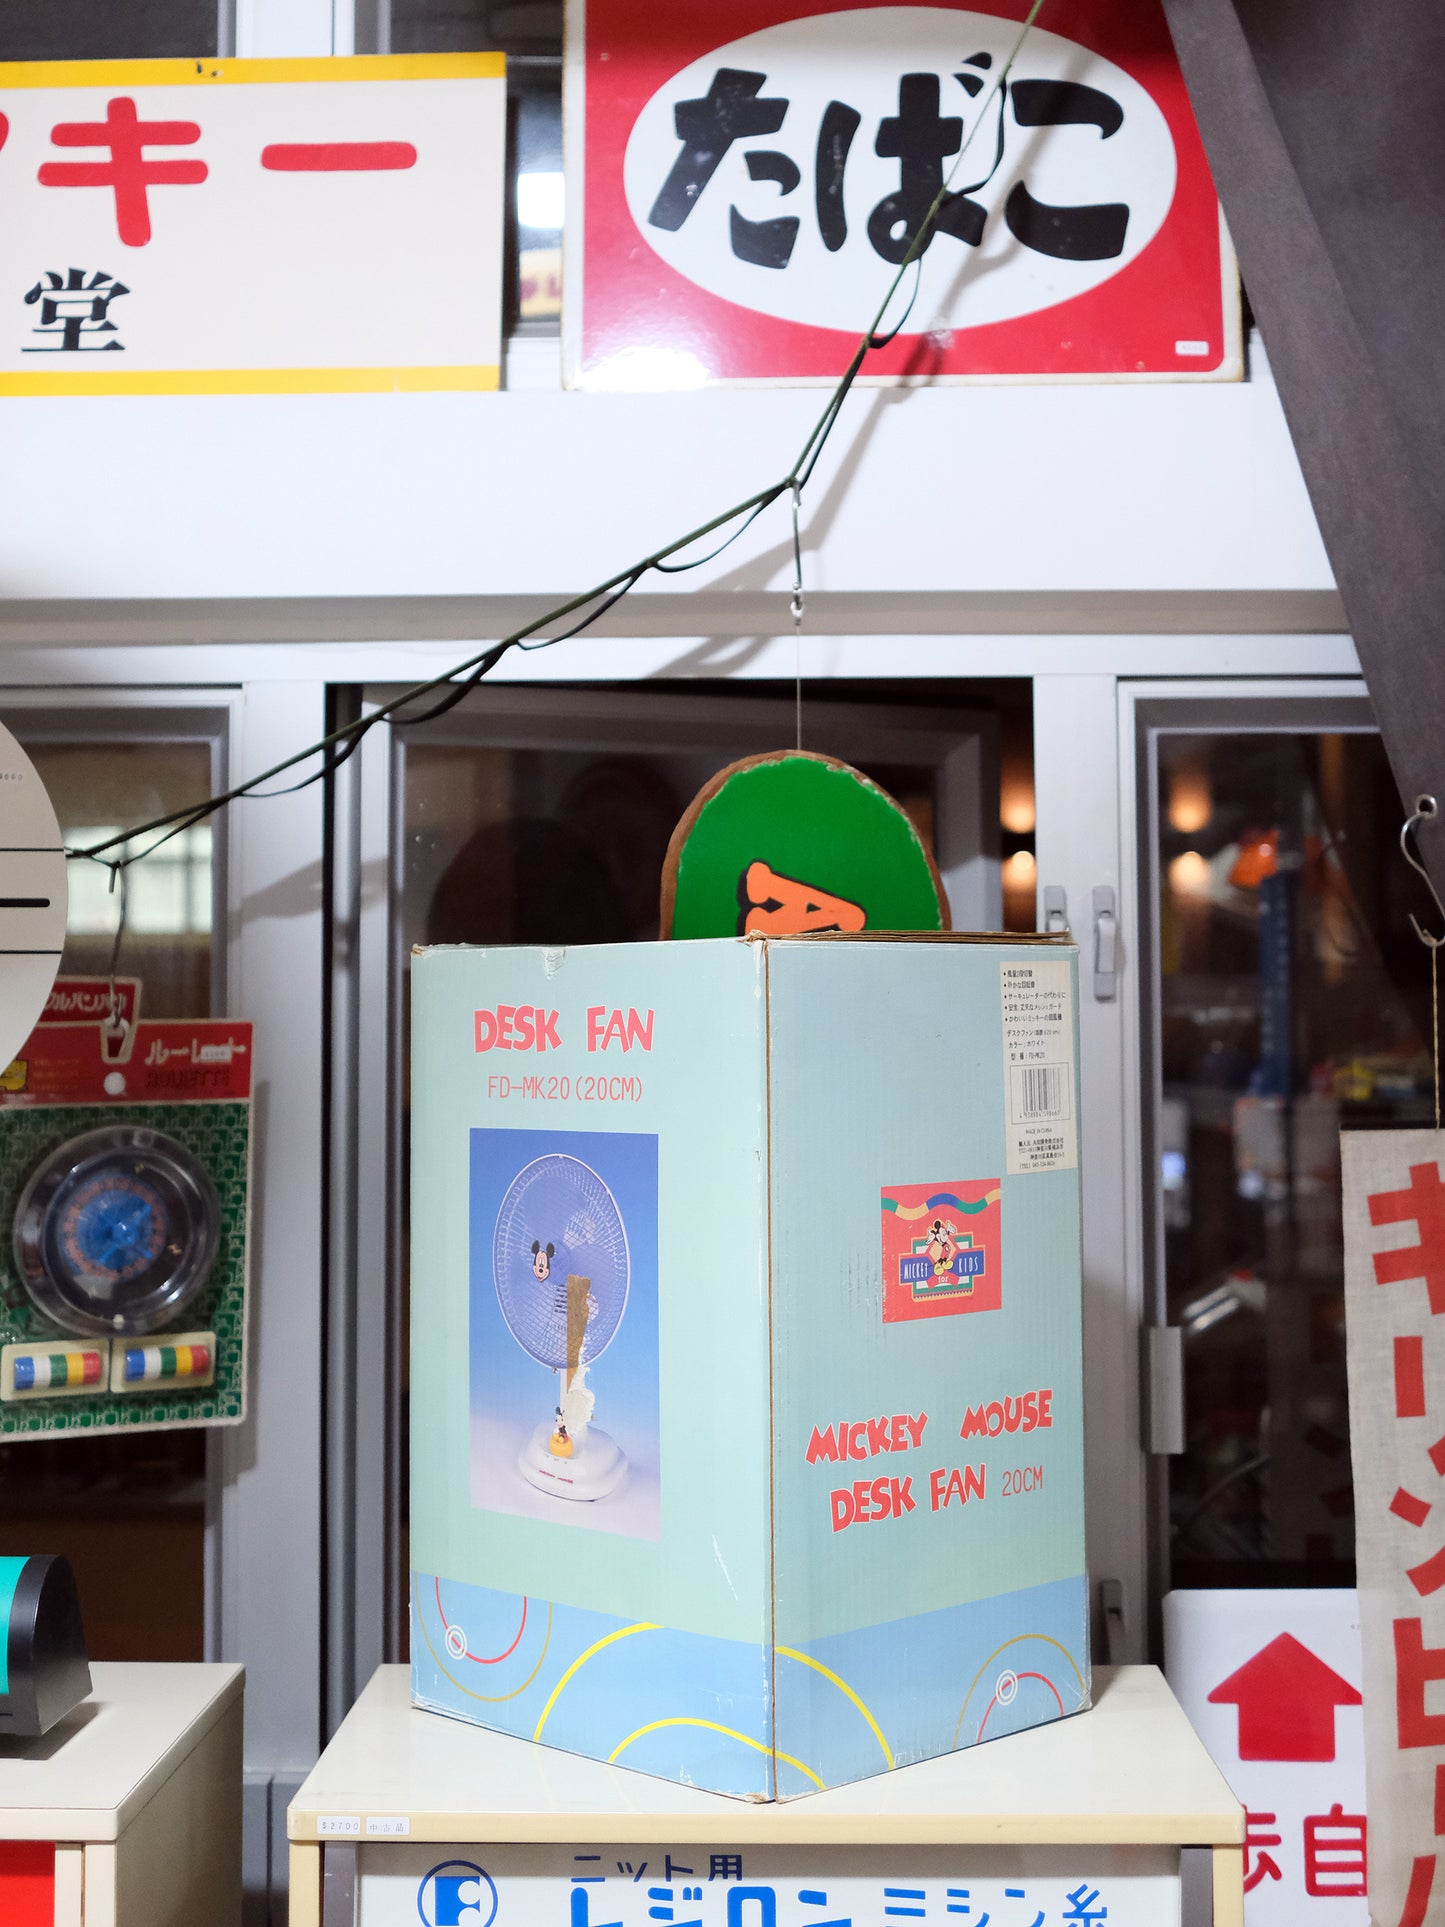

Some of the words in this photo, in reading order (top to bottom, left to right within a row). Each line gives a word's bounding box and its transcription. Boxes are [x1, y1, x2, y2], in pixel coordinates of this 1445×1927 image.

[0, 96, 418, 247] キー
[648, 52, 1130, 269] たばこ
[473, 1004, 562, 1053] DESK
[586, 1005, 655, 1053] FAN
[805, 1410, 928, 1465] MICKEY
[959, 1388, 1053, 1440] MOUSE
[830, 1475, 916, 1533] DESK
[929, 1463, 986, 1512] FAN
[1001, 1464, 1043, 1497] 20CM
[571, 1854, 742, 1882] ニット用
